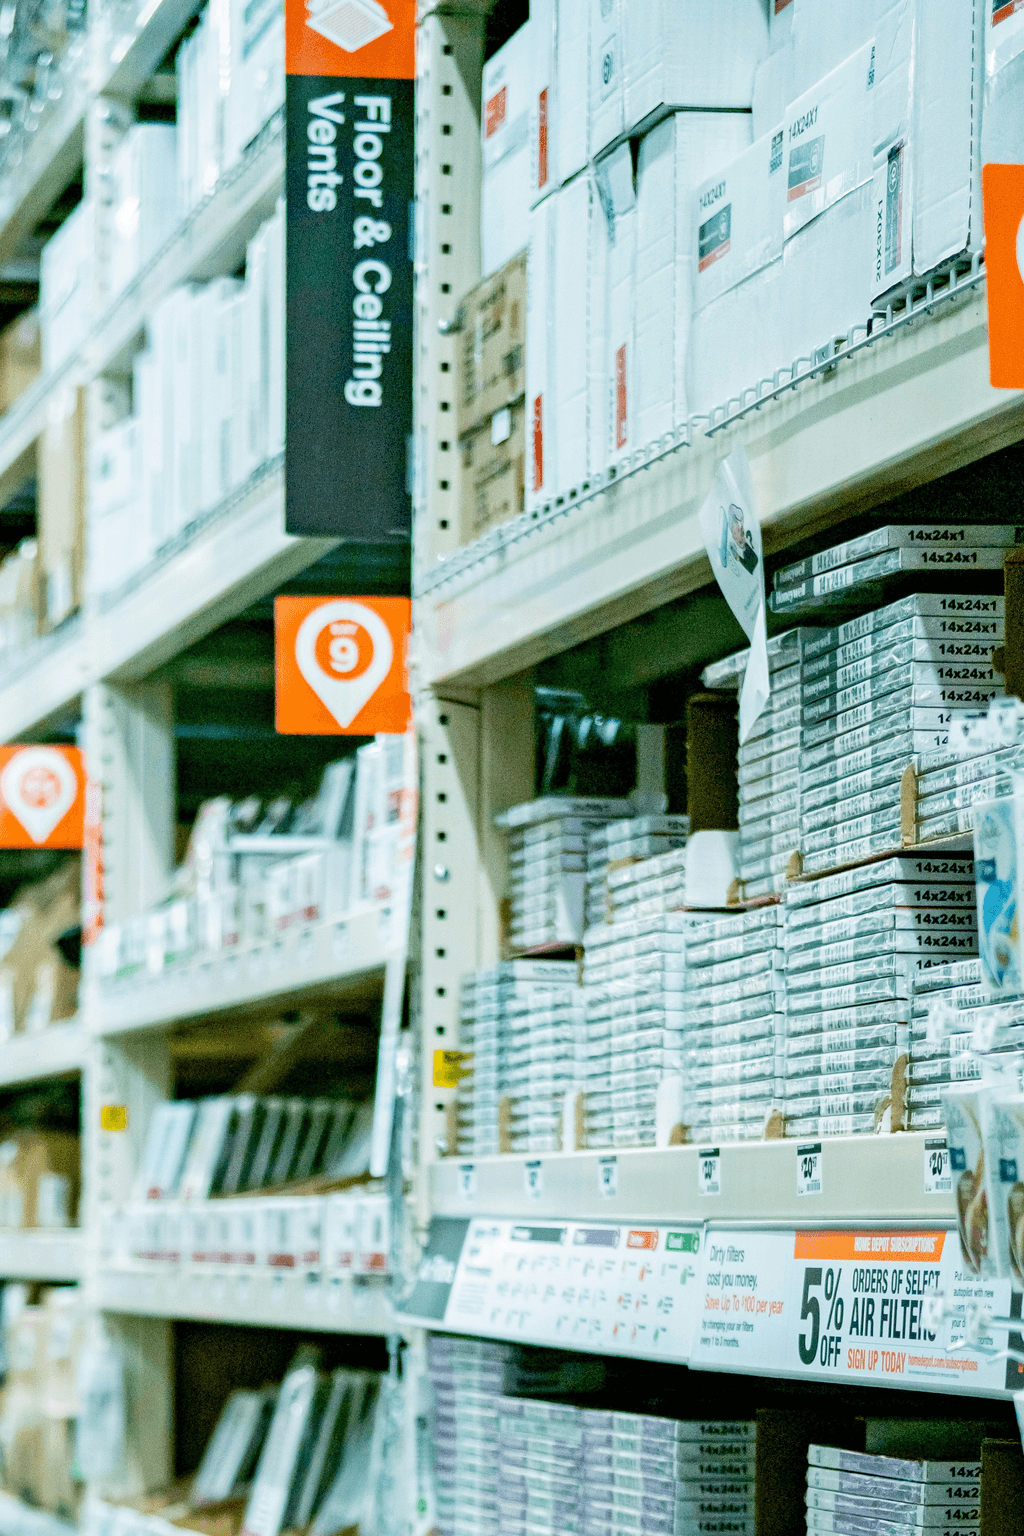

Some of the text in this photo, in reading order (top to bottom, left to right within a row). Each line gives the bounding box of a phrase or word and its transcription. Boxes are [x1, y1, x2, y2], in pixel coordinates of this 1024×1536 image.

[788, 106, 819, 142] 14X24X1
[307, 91, 346, 212] Vents
[875, 199, 884, 282] 20X30X1
[344, 94, 392, 407] Floor & Ceiling
[908, 530, 965, 541] 14x24x1
[921, 552, 977, 563] 14x24x1
[940, 600, 997, 611] 14x24x1
[940, 622, 997, 633] 14x24x1
[329, 637, 360, 673] 9
[938, 644, 995, 655] 14x24x1
[937, 668, 994, 679] 14x24x1
[940, 691, 996, 702] 14x24x1
[915, 862, 974, 874] 14x24x1
[914, 890, 972, 902] 14x24x1
[914, 914, 973, 925] 14x24x1
[916, 936, 974, 947] 14x24x1
[854, 1236, 871, 1251] HOME
[872, 1236, 889, 1252] DEPOT
[709, 1245, 745, 1266] Dirty filters
[707, 1272, 758, 1291] cost you money.
[852, 1267, 941, 1295] ORDERS OF SELECT
[704, 1294, 720, 1310] Save
[720, 1294, 731, 1312] Up
[732, 1295, 740, 1312] To
[756, 1300, 768, 1316] per
[768, 1300, 784, 1317] year
[849, 1297, 875, 1338] AIR
[820, 1334, 842, 1367] OFF
[847, 1347, 866, 1370] SIGN
[867, 1350, 879, 1371] UP
[881, 1350, 907, 1374] TODAY
[908, 1355, 978, 1372] homedepot.com/subscriptions
